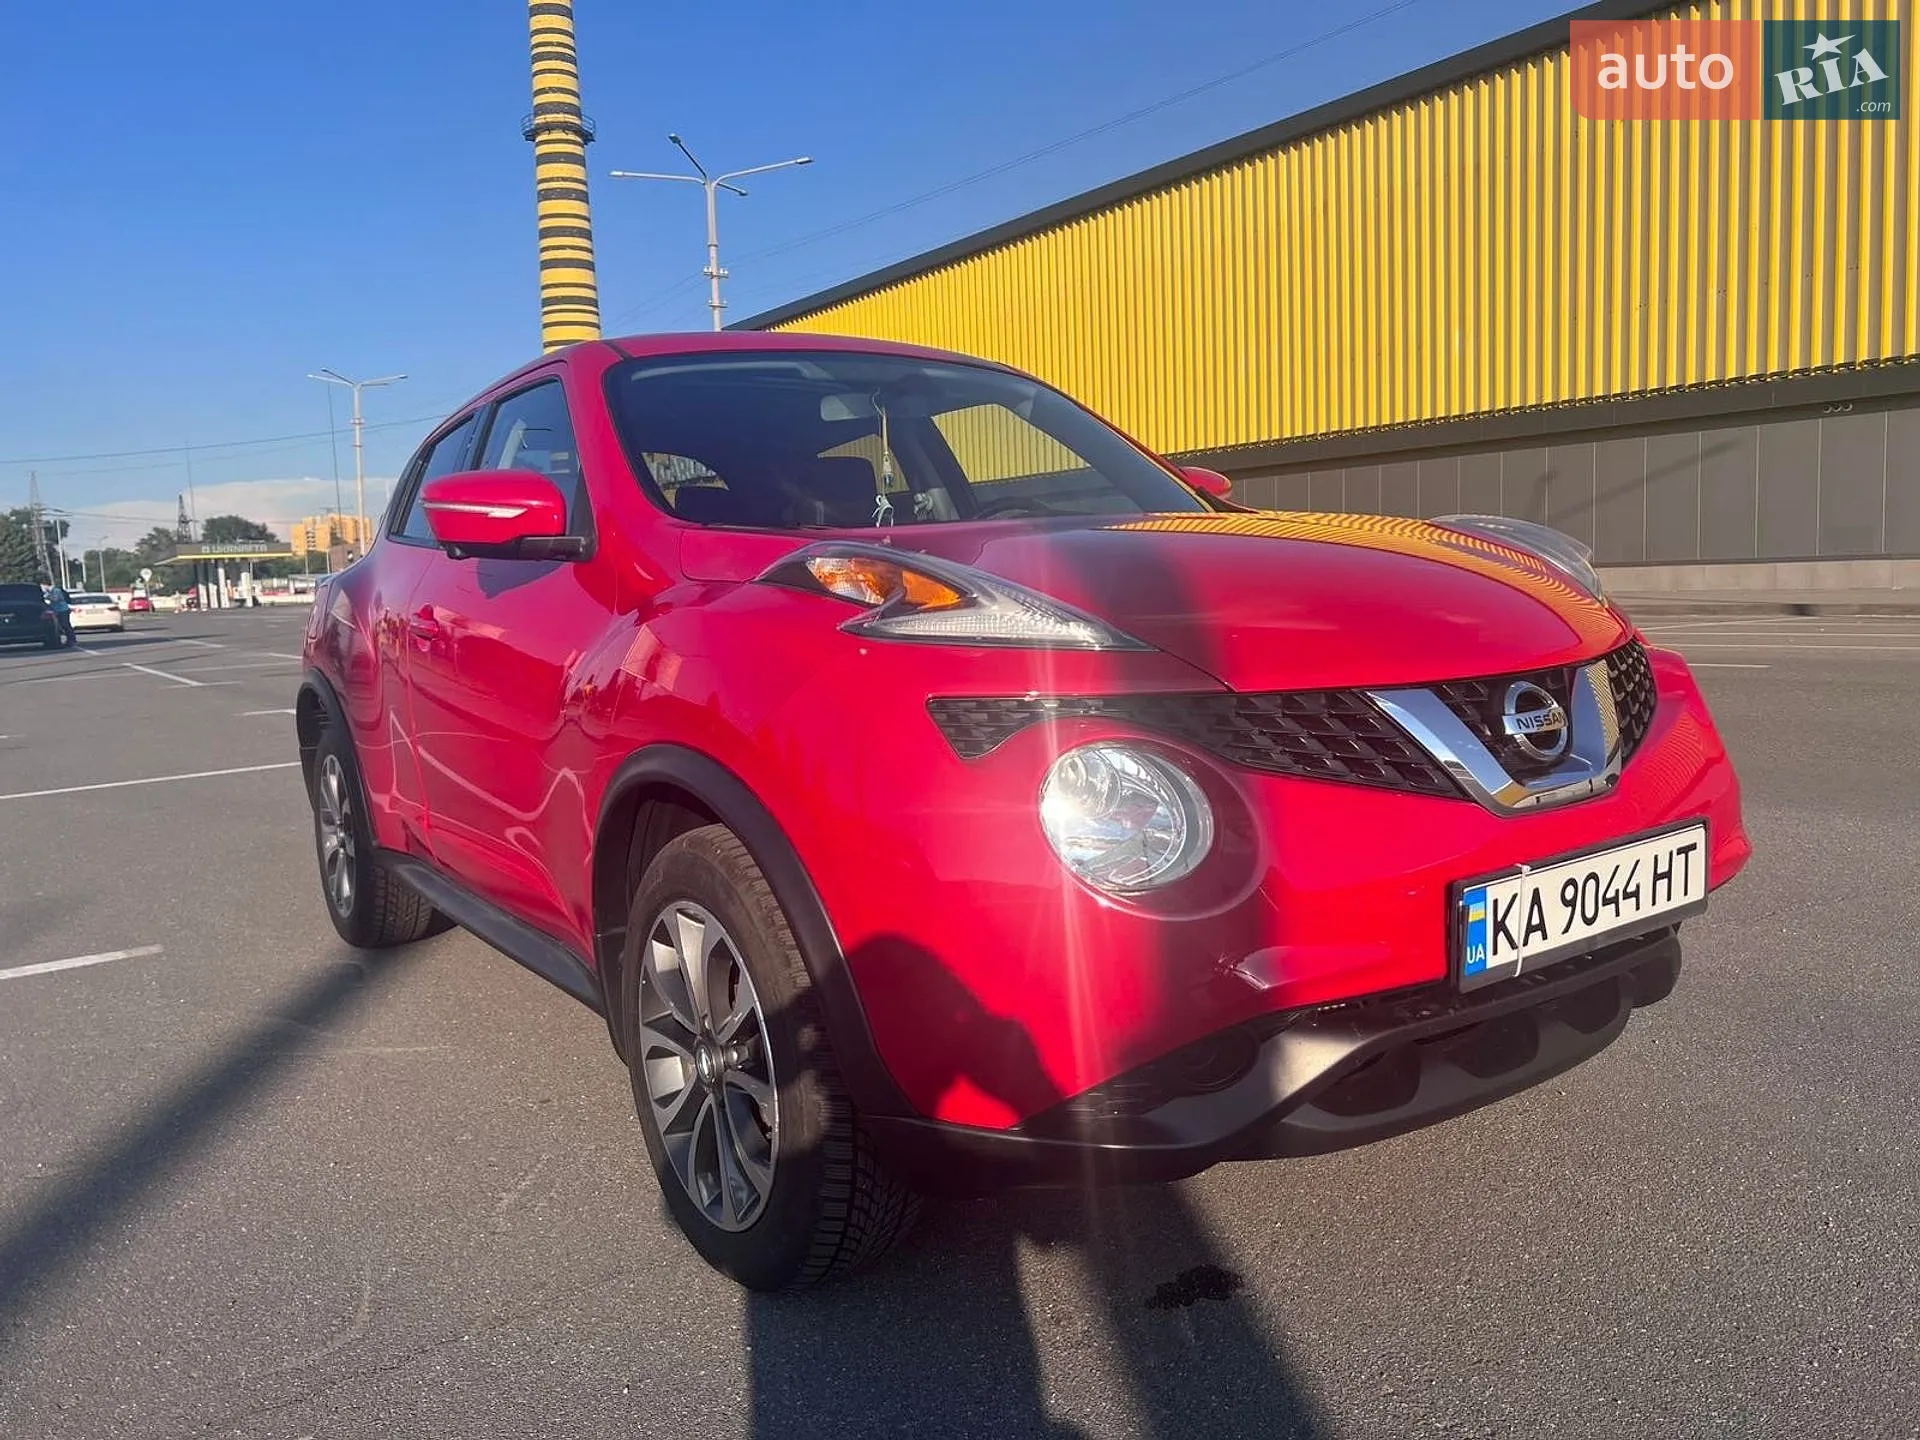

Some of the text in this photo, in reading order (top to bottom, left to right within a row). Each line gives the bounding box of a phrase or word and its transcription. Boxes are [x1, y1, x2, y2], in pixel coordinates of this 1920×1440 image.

[1491, 842, 1697, 956] KA 9044 HT
[1467, 944, 1485, 964] UA
